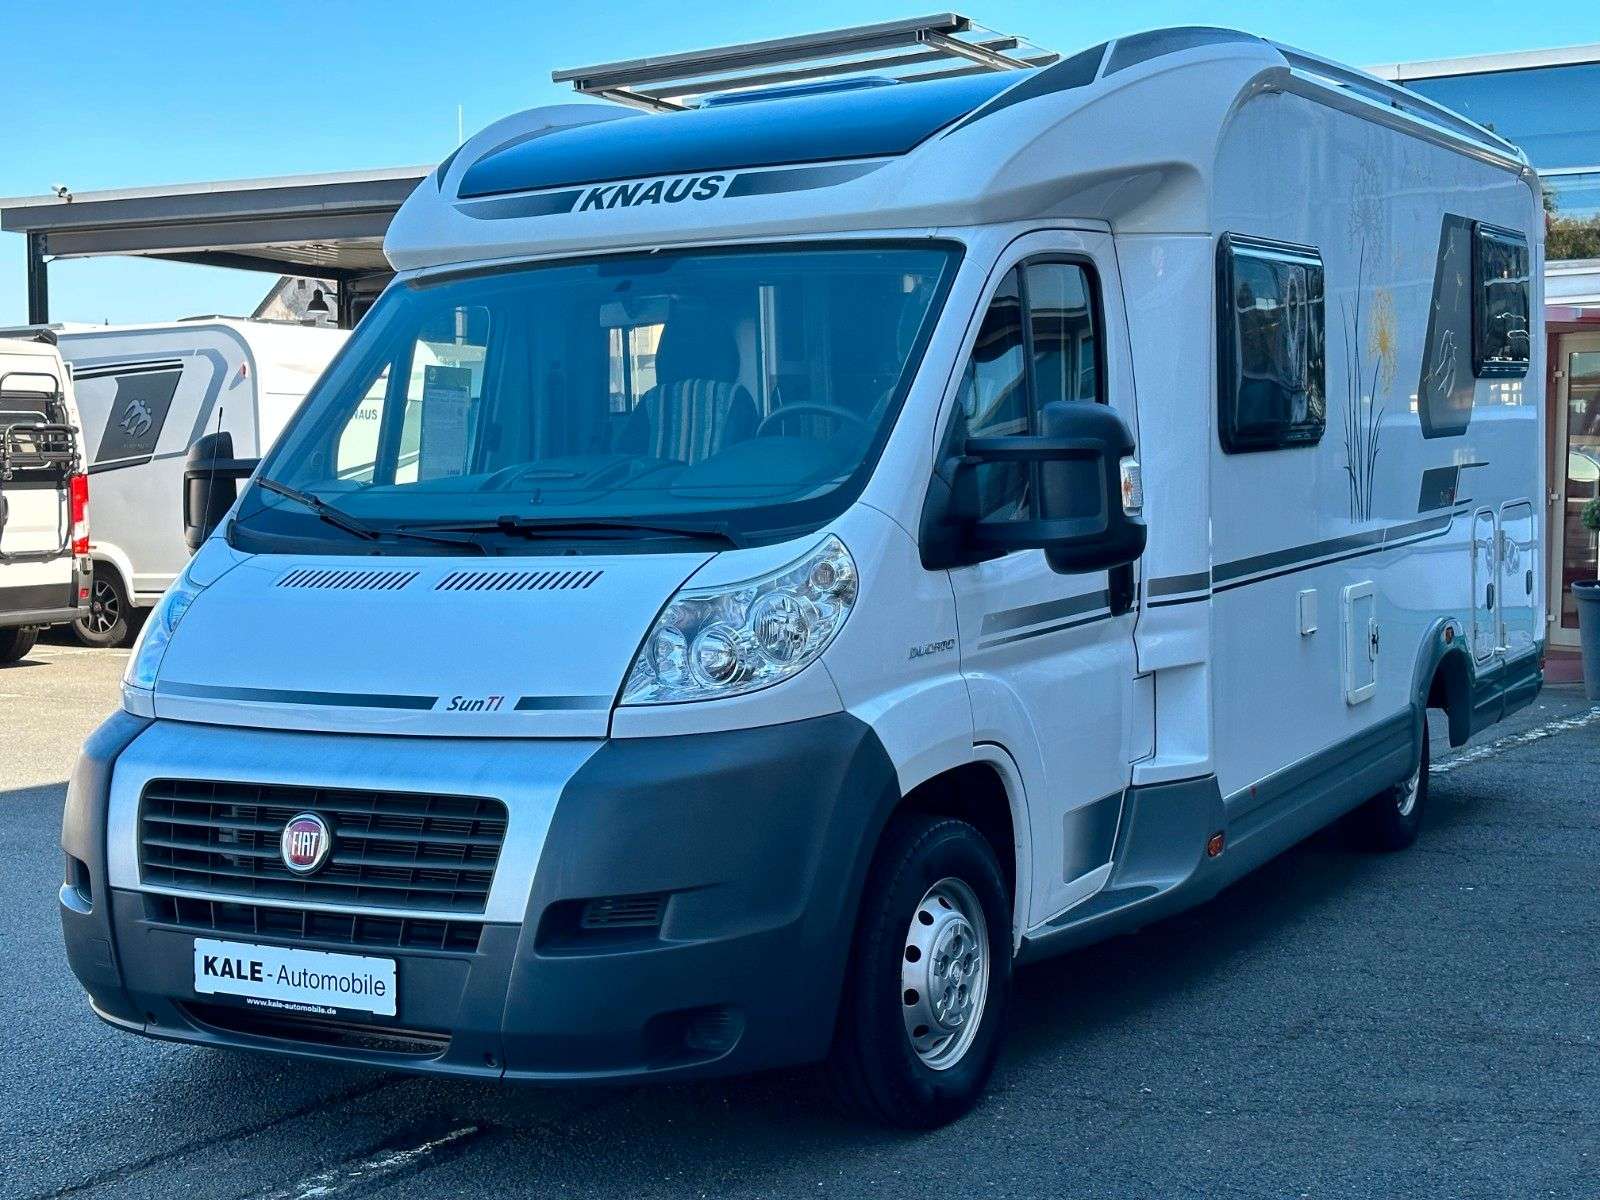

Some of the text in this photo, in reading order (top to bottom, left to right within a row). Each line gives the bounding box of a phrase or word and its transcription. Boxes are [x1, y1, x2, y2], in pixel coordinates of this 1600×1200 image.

[578, 175, 725, 212] KNAUS
[291, 831, 319, 857] FIAT
[203, 954, 264, 983] KALE
[276, 964, 387, 997] Automobile
[246, 998, 337, 1015] www.kale-automobile.de
